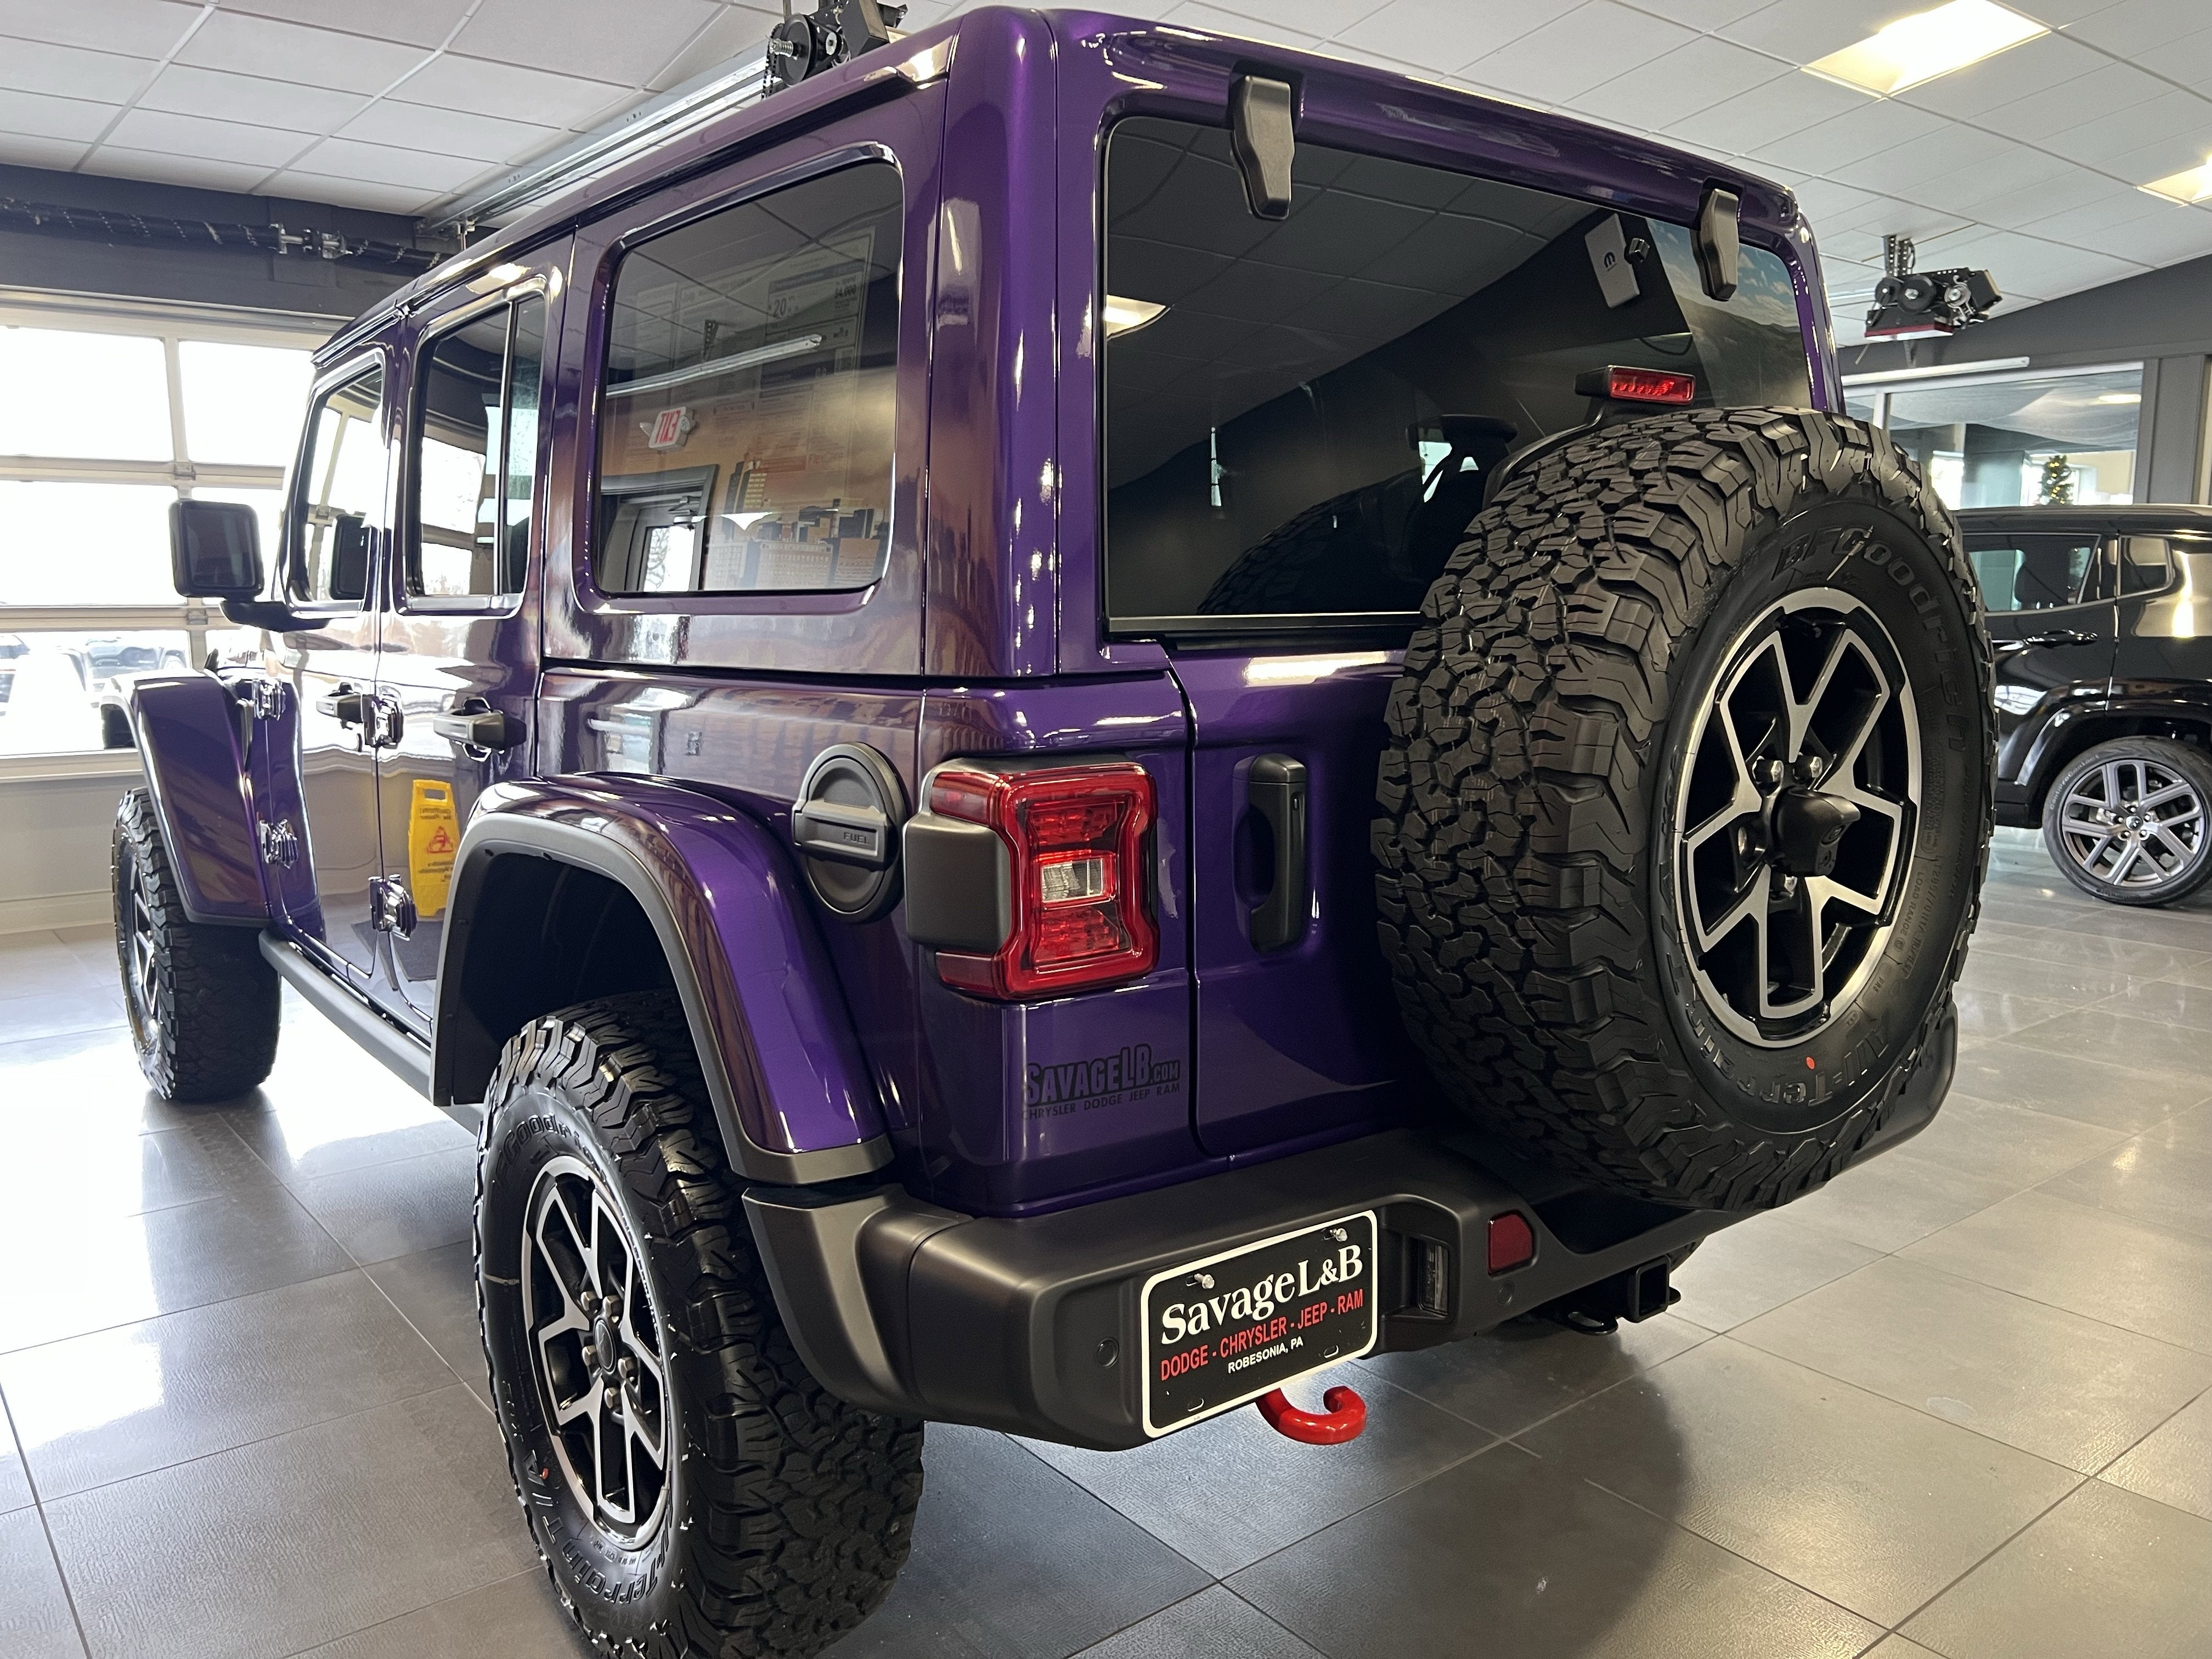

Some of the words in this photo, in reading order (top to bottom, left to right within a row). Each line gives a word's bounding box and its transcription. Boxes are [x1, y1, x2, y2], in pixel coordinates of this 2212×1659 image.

[772, 298, 787, 319] 20
[1771, 524, 1968, 754] BFGoodrich
[843, 832, 870, 845] FUEL
[1912, 871, 1925, 900] LOAD
[1900, 902, 1916, 938] RANGE
[1685, 1002, 1889, 1107] All-Terrain
[1023, 1103, 1076, 1121] CHRYSLER
[1084, 1093, 1122, 1111] DODGE
[1128, 1088, 1150, 1102] JEEP
[1156, 1082, 1180, 1096] RAM
[1160, 1346, 1209, 1381] DODGE
[1220, 1317, 1286, 1359] CHRYSLER
[1297, 1303, 1328, 1330] JEEP
[1337, 1289, 1363, 1316] RAM
[1227, 1346, 1288, 1373] ROBESONIA,
[1290, 1337, 1304, 1352] PA
